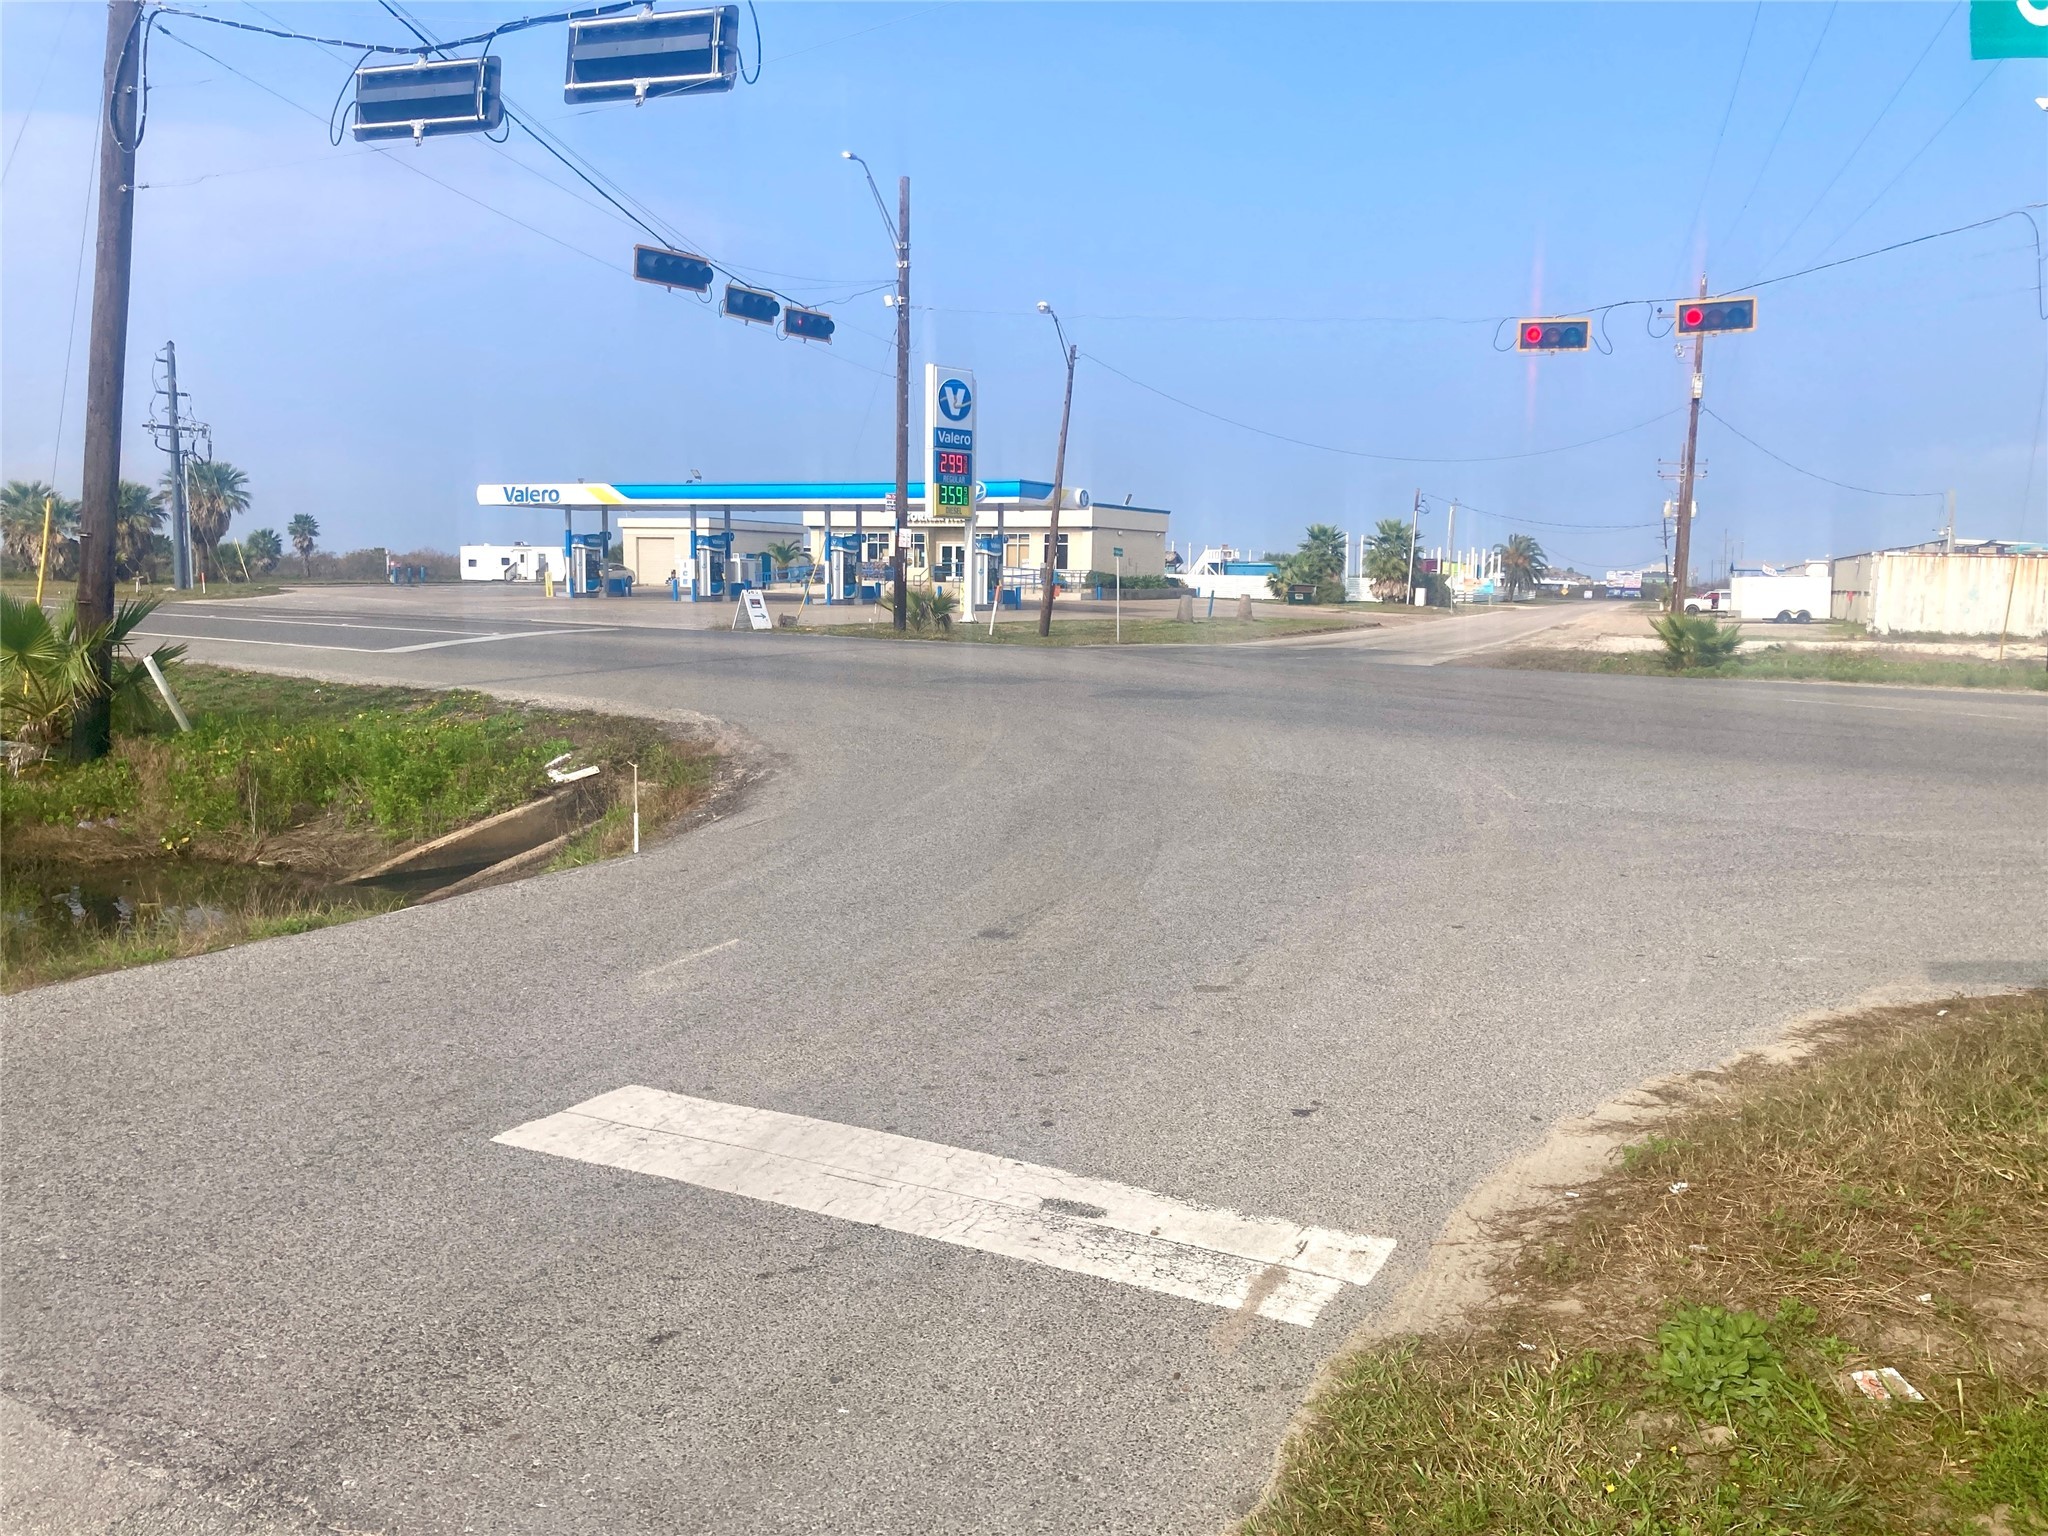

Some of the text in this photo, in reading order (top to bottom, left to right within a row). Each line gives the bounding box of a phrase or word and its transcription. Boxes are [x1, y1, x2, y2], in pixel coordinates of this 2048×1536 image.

[938, 430, 971, 445] Valero
[943, 475, 966, 484] REGULAR
[503, 486, 560, 503] Valero
[946, 507, 962, 515] DIESEL
